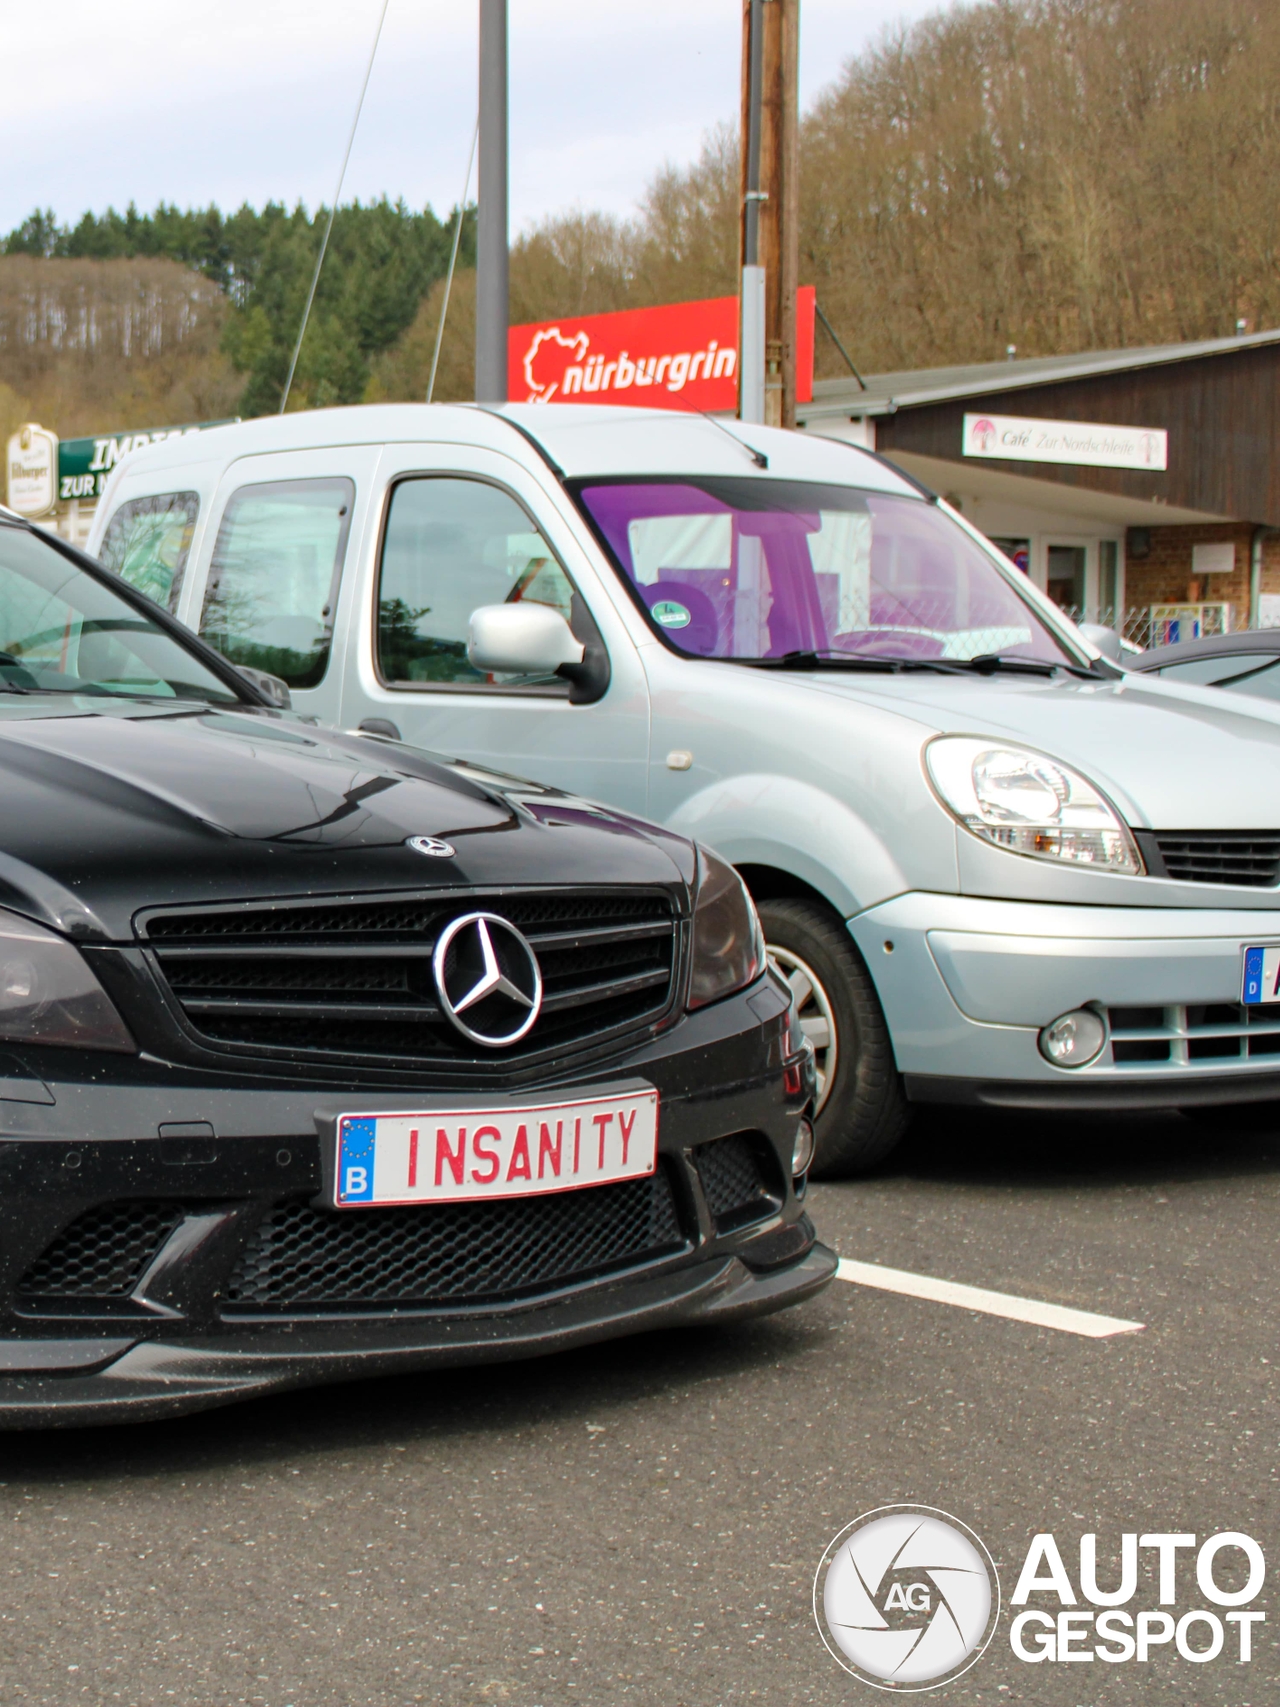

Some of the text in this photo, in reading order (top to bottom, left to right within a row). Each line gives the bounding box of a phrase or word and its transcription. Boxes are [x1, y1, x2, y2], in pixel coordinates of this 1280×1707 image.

[563, 340, 738, 394] nürburgrin
[1001, 428, 1135, 456] Café Zur Nordschleife
[61, 473, 95, 498] ZUR
[1249, 981, 1258, 995] D
[407, 1108, 637, 1188] INSANITY
[345, 1166, 368, 1194] B
